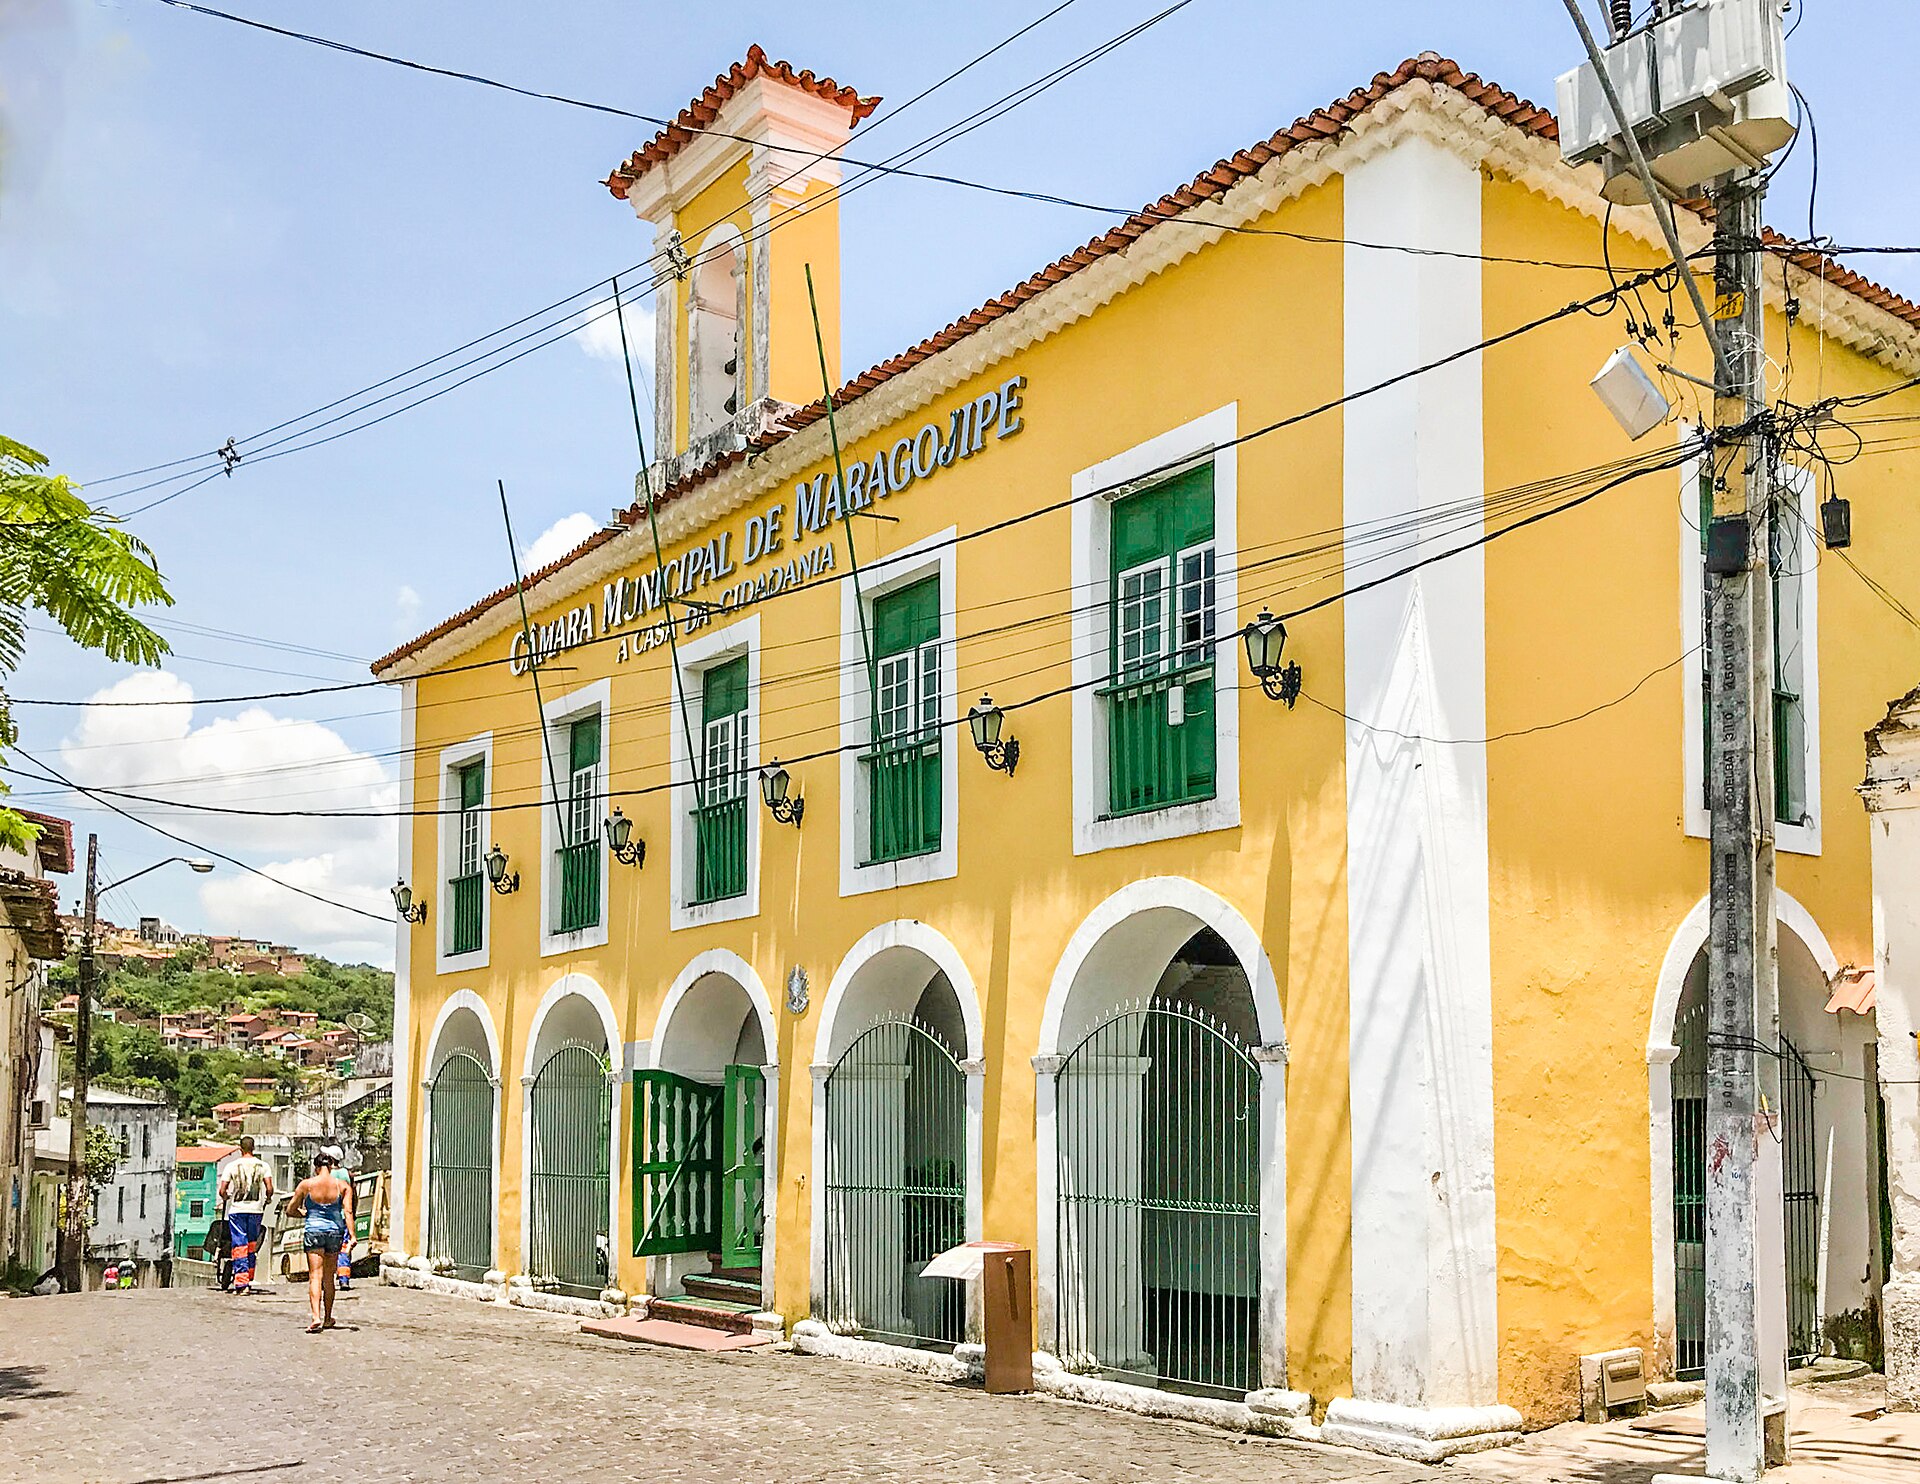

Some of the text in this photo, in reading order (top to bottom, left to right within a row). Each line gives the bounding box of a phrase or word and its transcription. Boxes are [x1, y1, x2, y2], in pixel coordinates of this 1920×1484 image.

[509, 375, 1026, 677] CÂMARA MUNICIPAL DE MARAGOJIPE
[616, 541, 837, 664] A CASA DA CIDADANIA
[1724, 755, 1735, 803] COELBA
